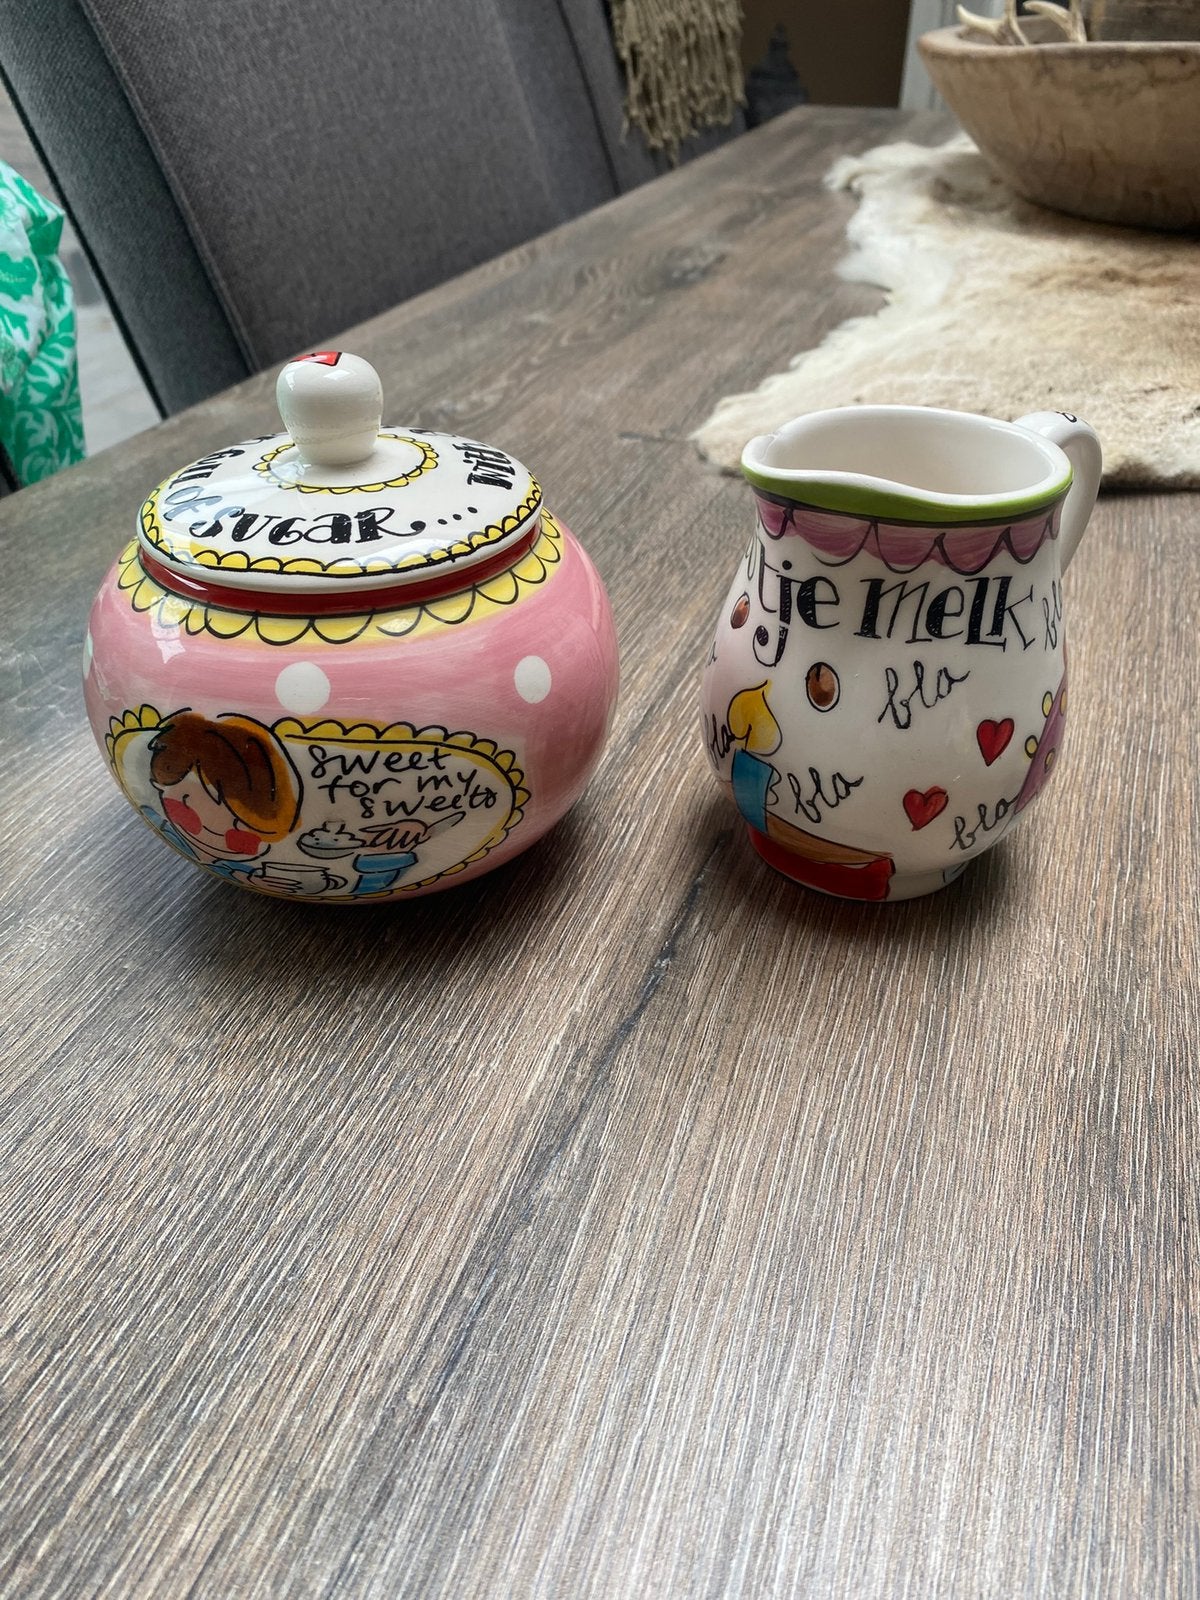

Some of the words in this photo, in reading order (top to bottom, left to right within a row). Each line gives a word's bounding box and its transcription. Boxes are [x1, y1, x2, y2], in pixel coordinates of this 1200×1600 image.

[877, 659, 971, 730] bla
[308, 744, 452, 778] sweet
[317, 774, 402, 804] for
[417, 769, 478, 797] my
[786, 766, 864, 824] bla
[948, 797, 1021, 851] bla
